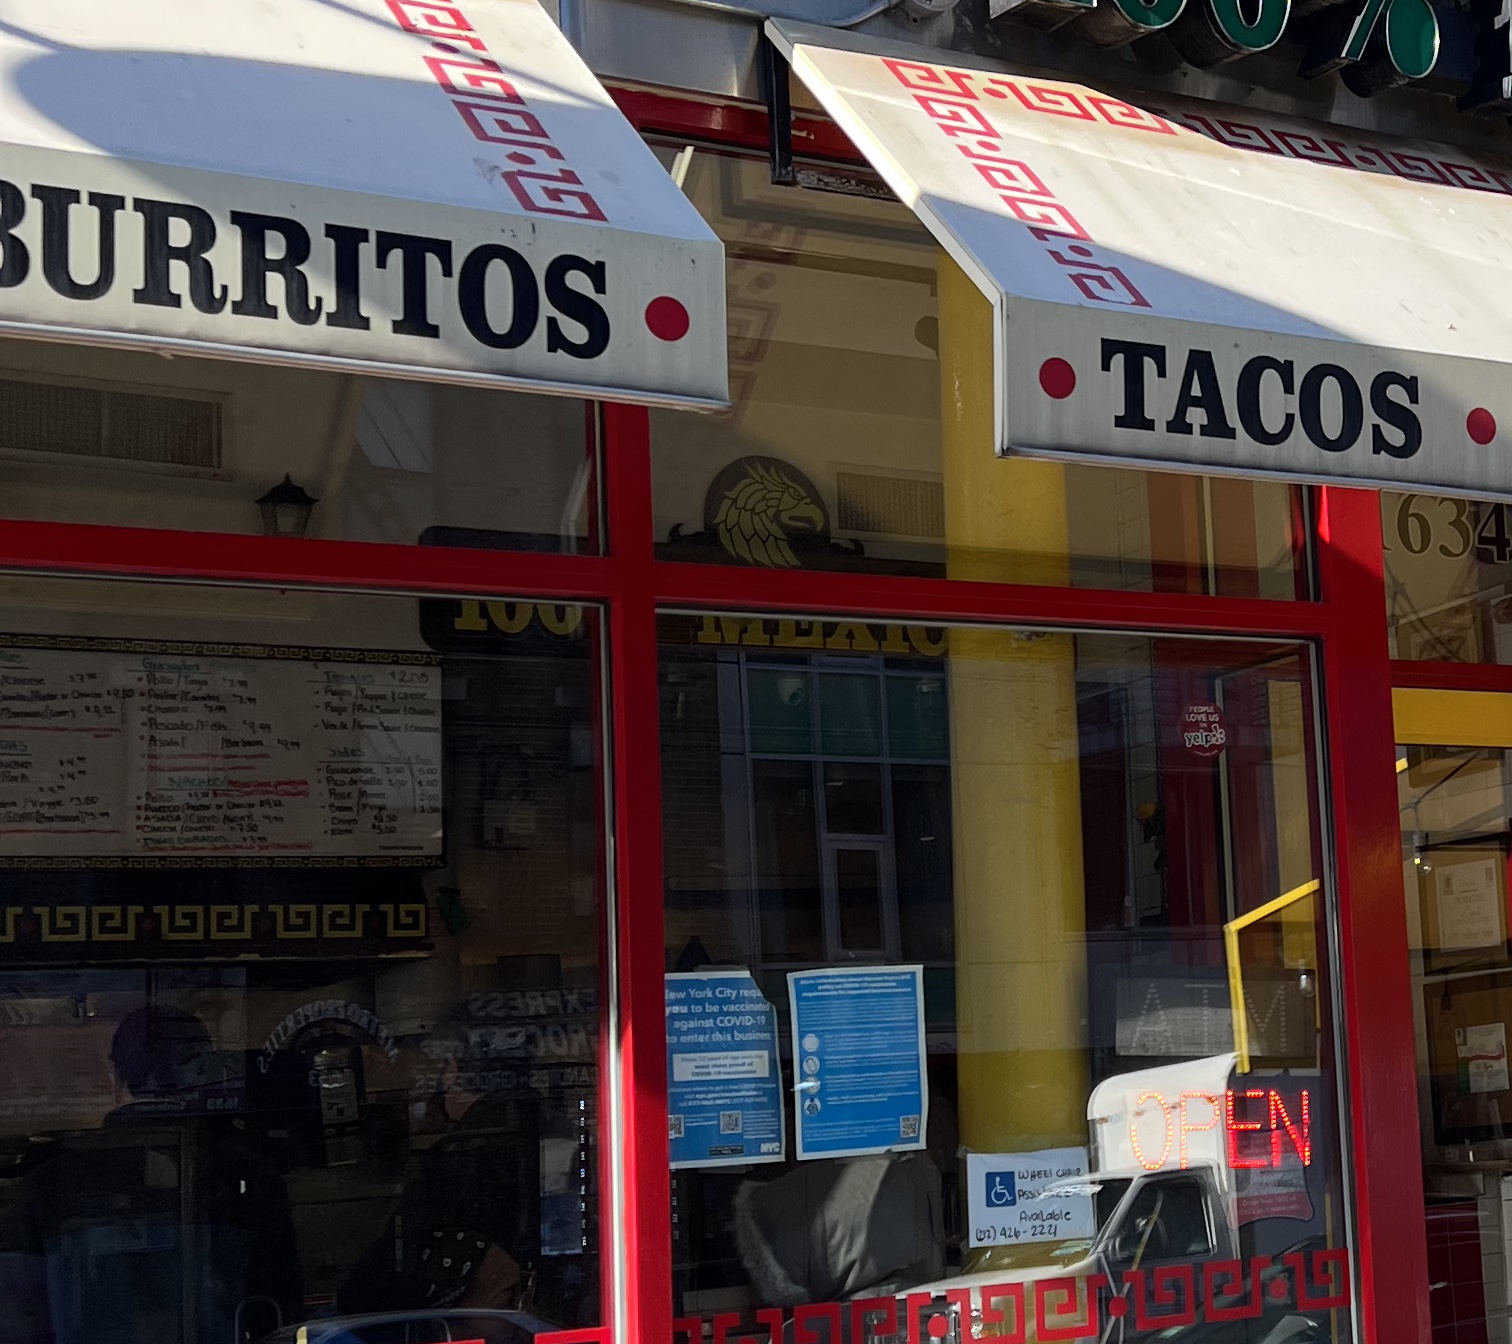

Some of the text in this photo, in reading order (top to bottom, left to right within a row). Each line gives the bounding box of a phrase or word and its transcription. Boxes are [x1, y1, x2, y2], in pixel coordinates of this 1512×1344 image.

[1101, 338, 1422, 459] TACOS
[1382, 493, 1512, 562] 634
[1185, 713, 1220, 722] LOVE US
[1185, 730, 1212, 747] yelp
[688, 988, 713, 998] York
[715, 987, 737, 1000] City
[665, 1005, 688, 1016] you
[690, 1004, 703, 1013] to
[705, 1002, 719, 1013] be
[673, 1015, 766, 1031] against COVID-19
[666, 1034, 677, 1043] to
[679, 1034, 710, 1043] enter
[711, 1031, 732, 1042] this
[1130, 1089, 1312, 1170] OPEN
